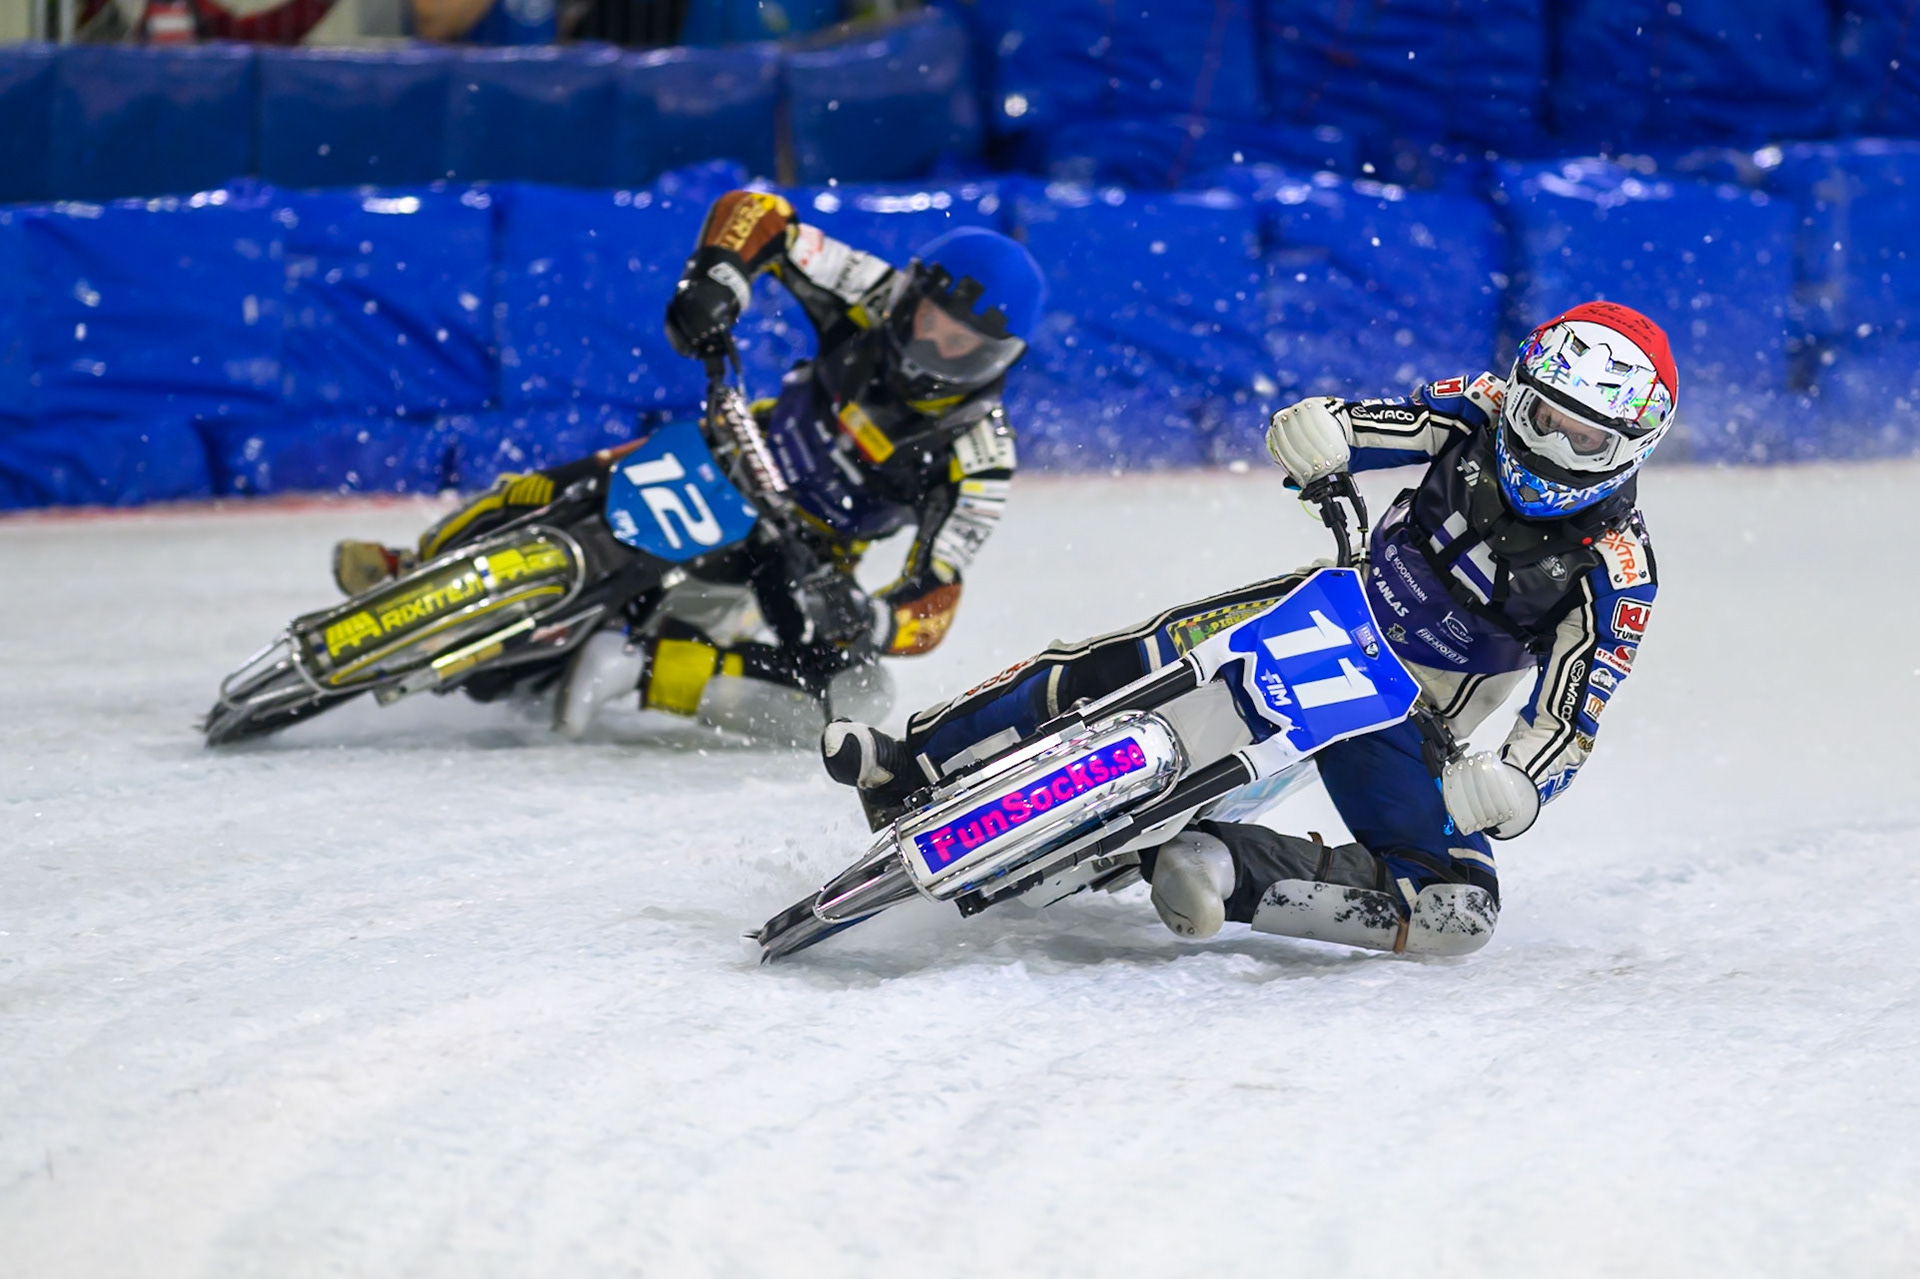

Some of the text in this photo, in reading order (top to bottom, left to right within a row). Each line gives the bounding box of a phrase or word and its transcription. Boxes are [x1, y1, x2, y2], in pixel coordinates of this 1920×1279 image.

[1369, 409, 1415, 422] WACO
[1474, 377, 1504, 411] FLE
[623, 452, 723, 550] 12
[1376, 580, 1410, 618] ANLAS
[1394, 555, 1428, 602] KOOPMANN
[1263, 609, 1378, 710] 11
[1261, 668, 1293, 707] FIM
[929, 742, 1146, 863] FunSocks.se
